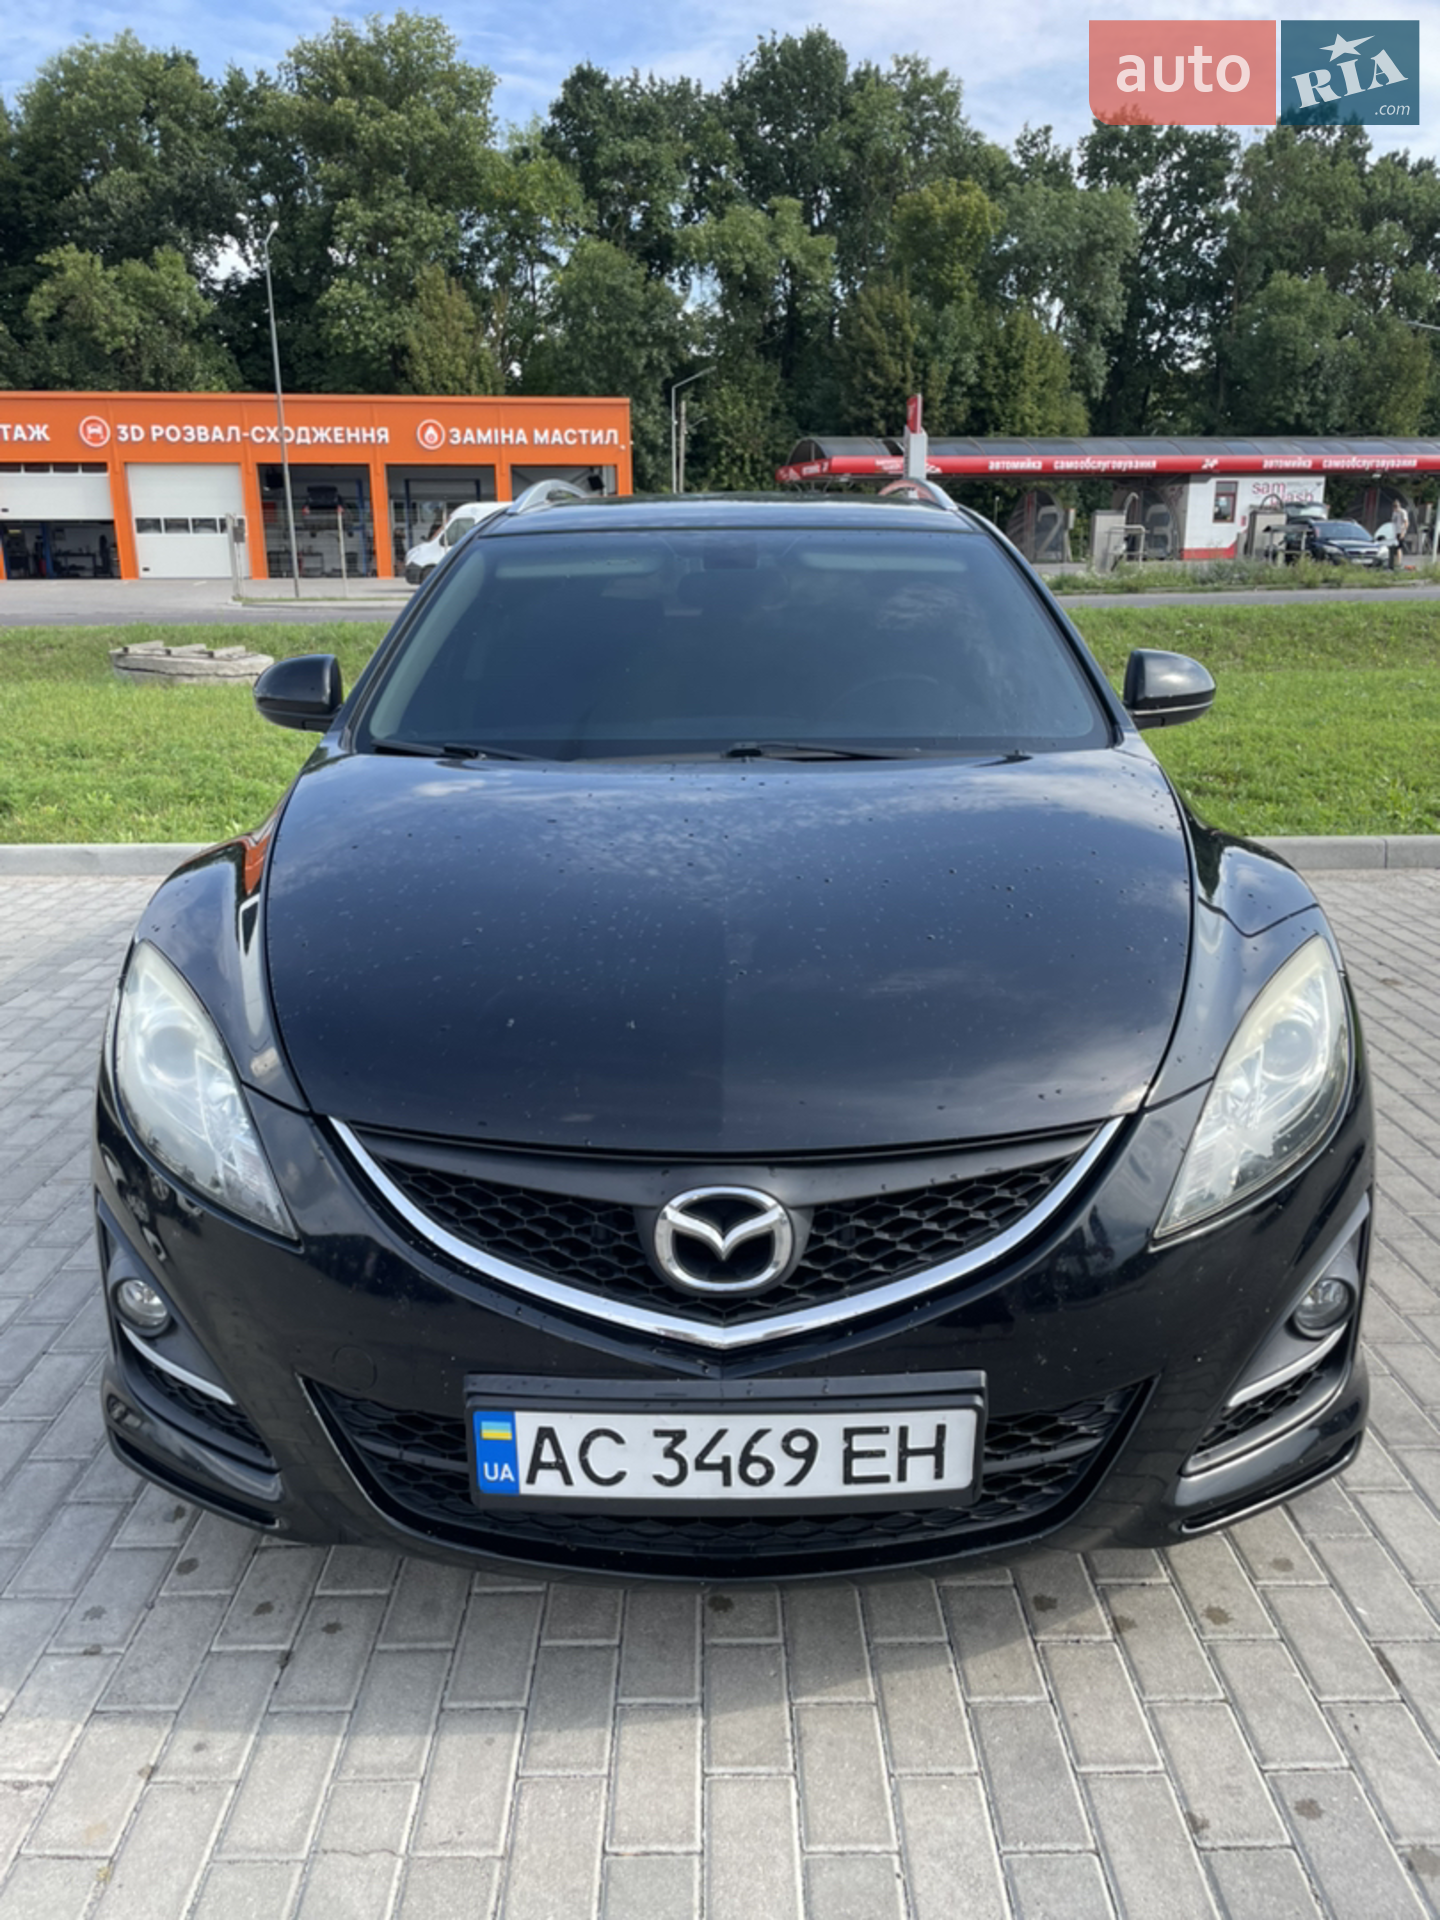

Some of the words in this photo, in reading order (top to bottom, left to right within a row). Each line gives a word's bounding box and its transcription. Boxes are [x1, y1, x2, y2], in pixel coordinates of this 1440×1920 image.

[116, 424, 145, 442] 3D
[151, 425, 390, 445] РОЗВАЛ-СХОДЖЕННЯ
[449, 427, 528, 446] ЗАМІНА
[533, 427, 620, 446] МАСТИЛ
[1251, 481, 1287, 495] sam
[525, 1426, 628, 1487] AC
[651, 1427, 819, 1488] 3469
[842, 1423, 947, 1486] EH
[483, 1462, 515, 1483] UA
